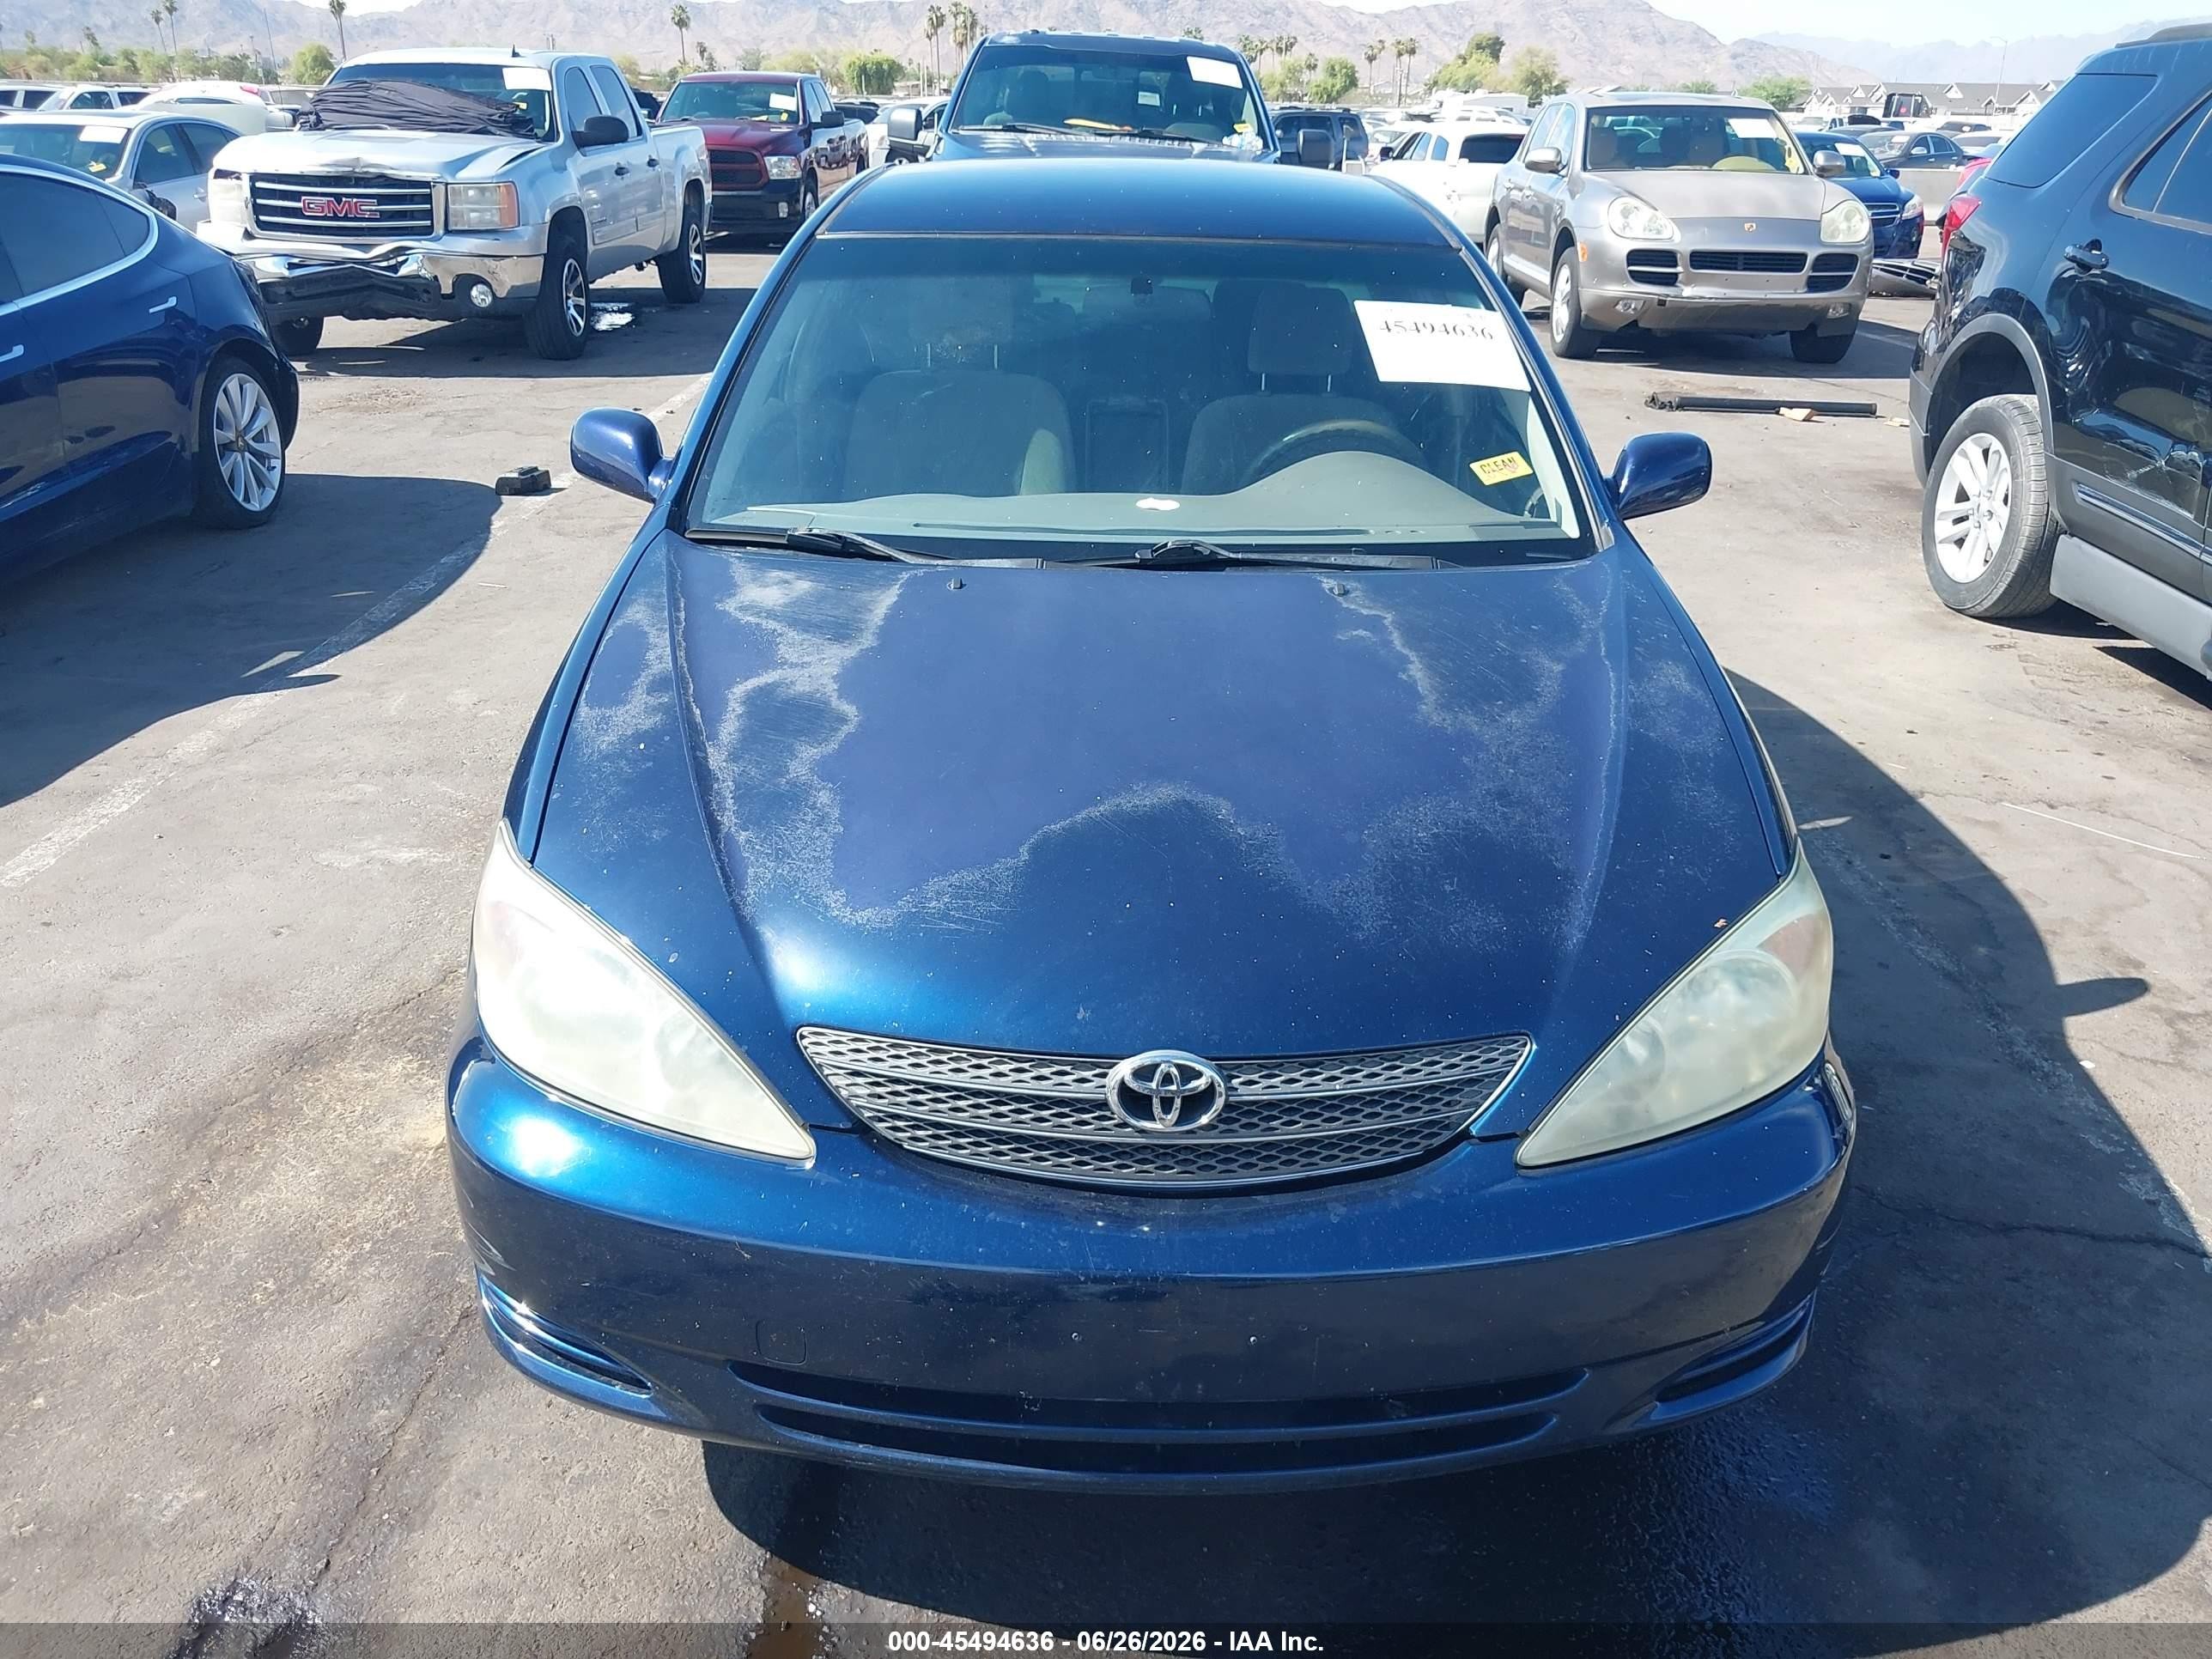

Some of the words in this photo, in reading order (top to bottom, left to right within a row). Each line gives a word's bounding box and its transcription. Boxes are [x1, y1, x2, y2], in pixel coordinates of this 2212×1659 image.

[301, 196, 380, 218] GMC
[1379, 319, 1493, 340] 45494636
[1480, 456, 1516, 474] CLEAN
